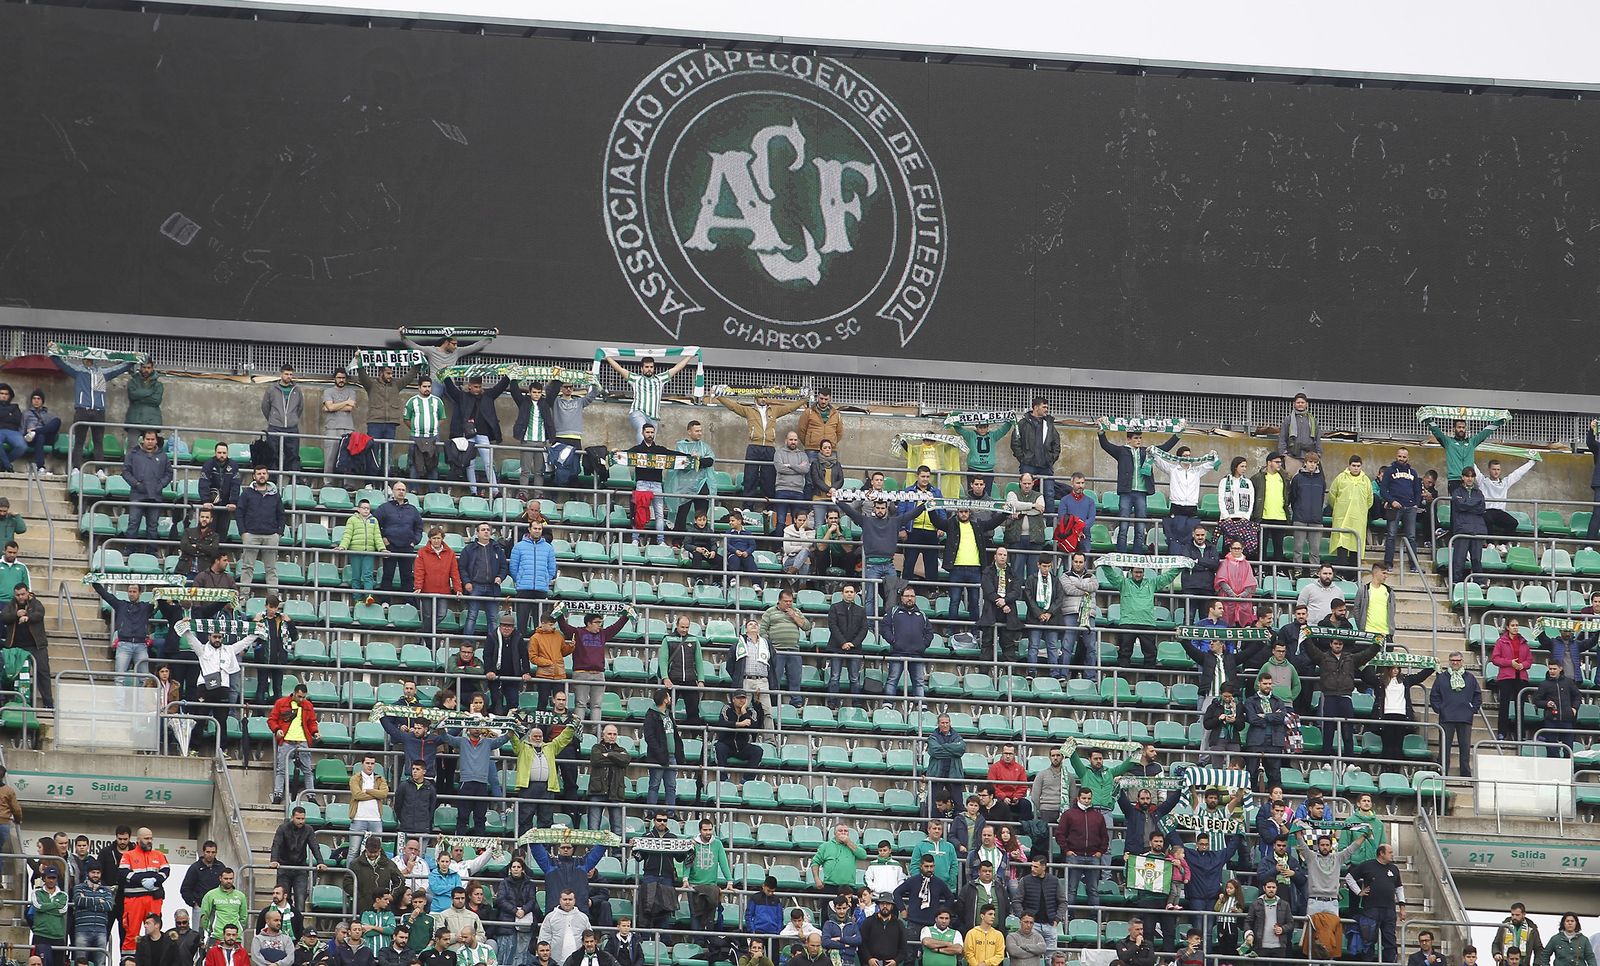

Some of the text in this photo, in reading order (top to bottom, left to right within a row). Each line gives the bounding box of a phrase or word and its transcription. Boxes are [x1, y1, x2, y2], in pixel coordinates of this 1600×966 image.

[660, 51, 891, 129] CHAPECOENSE
[888, 131, 924, 175] DE
[891, 184, 938, 321] FUTEBOL
[723, 316, 822, 349] CHAPECO
[835, 317, 861, 341] SC
[363, 352, 420, 363] REAL BETIS
[528, 367, 552, 376] REAL
[960, 411, 1015, 422] REAL BETIS
[1437, 408, 1495, 417] REAL BETIS
[1116, 418, 1142, 426] REAL
[197, 588, 229, 597] BETIS
[565, 601, 591, 610] REAL
[594, 603, 624, 612] BETIS
[1182, 628, 1269, 639] REAL BETIS
[527, 715, 559, 725] BETIS
[47, 784, 74, 796] 215
[91, 781, 128, 792] Salida
[101, 792, 117, 801] Exit
[145, 789, 172, 801] 215
[1207, 820, 1236, 831] BETIS
[1469, 852, 1495, 863] 217
[1511, 850, 1546, 862] Salida
[1562, 856, 1588, 867] 217
[1520, 860, 1535, 870] Exit
